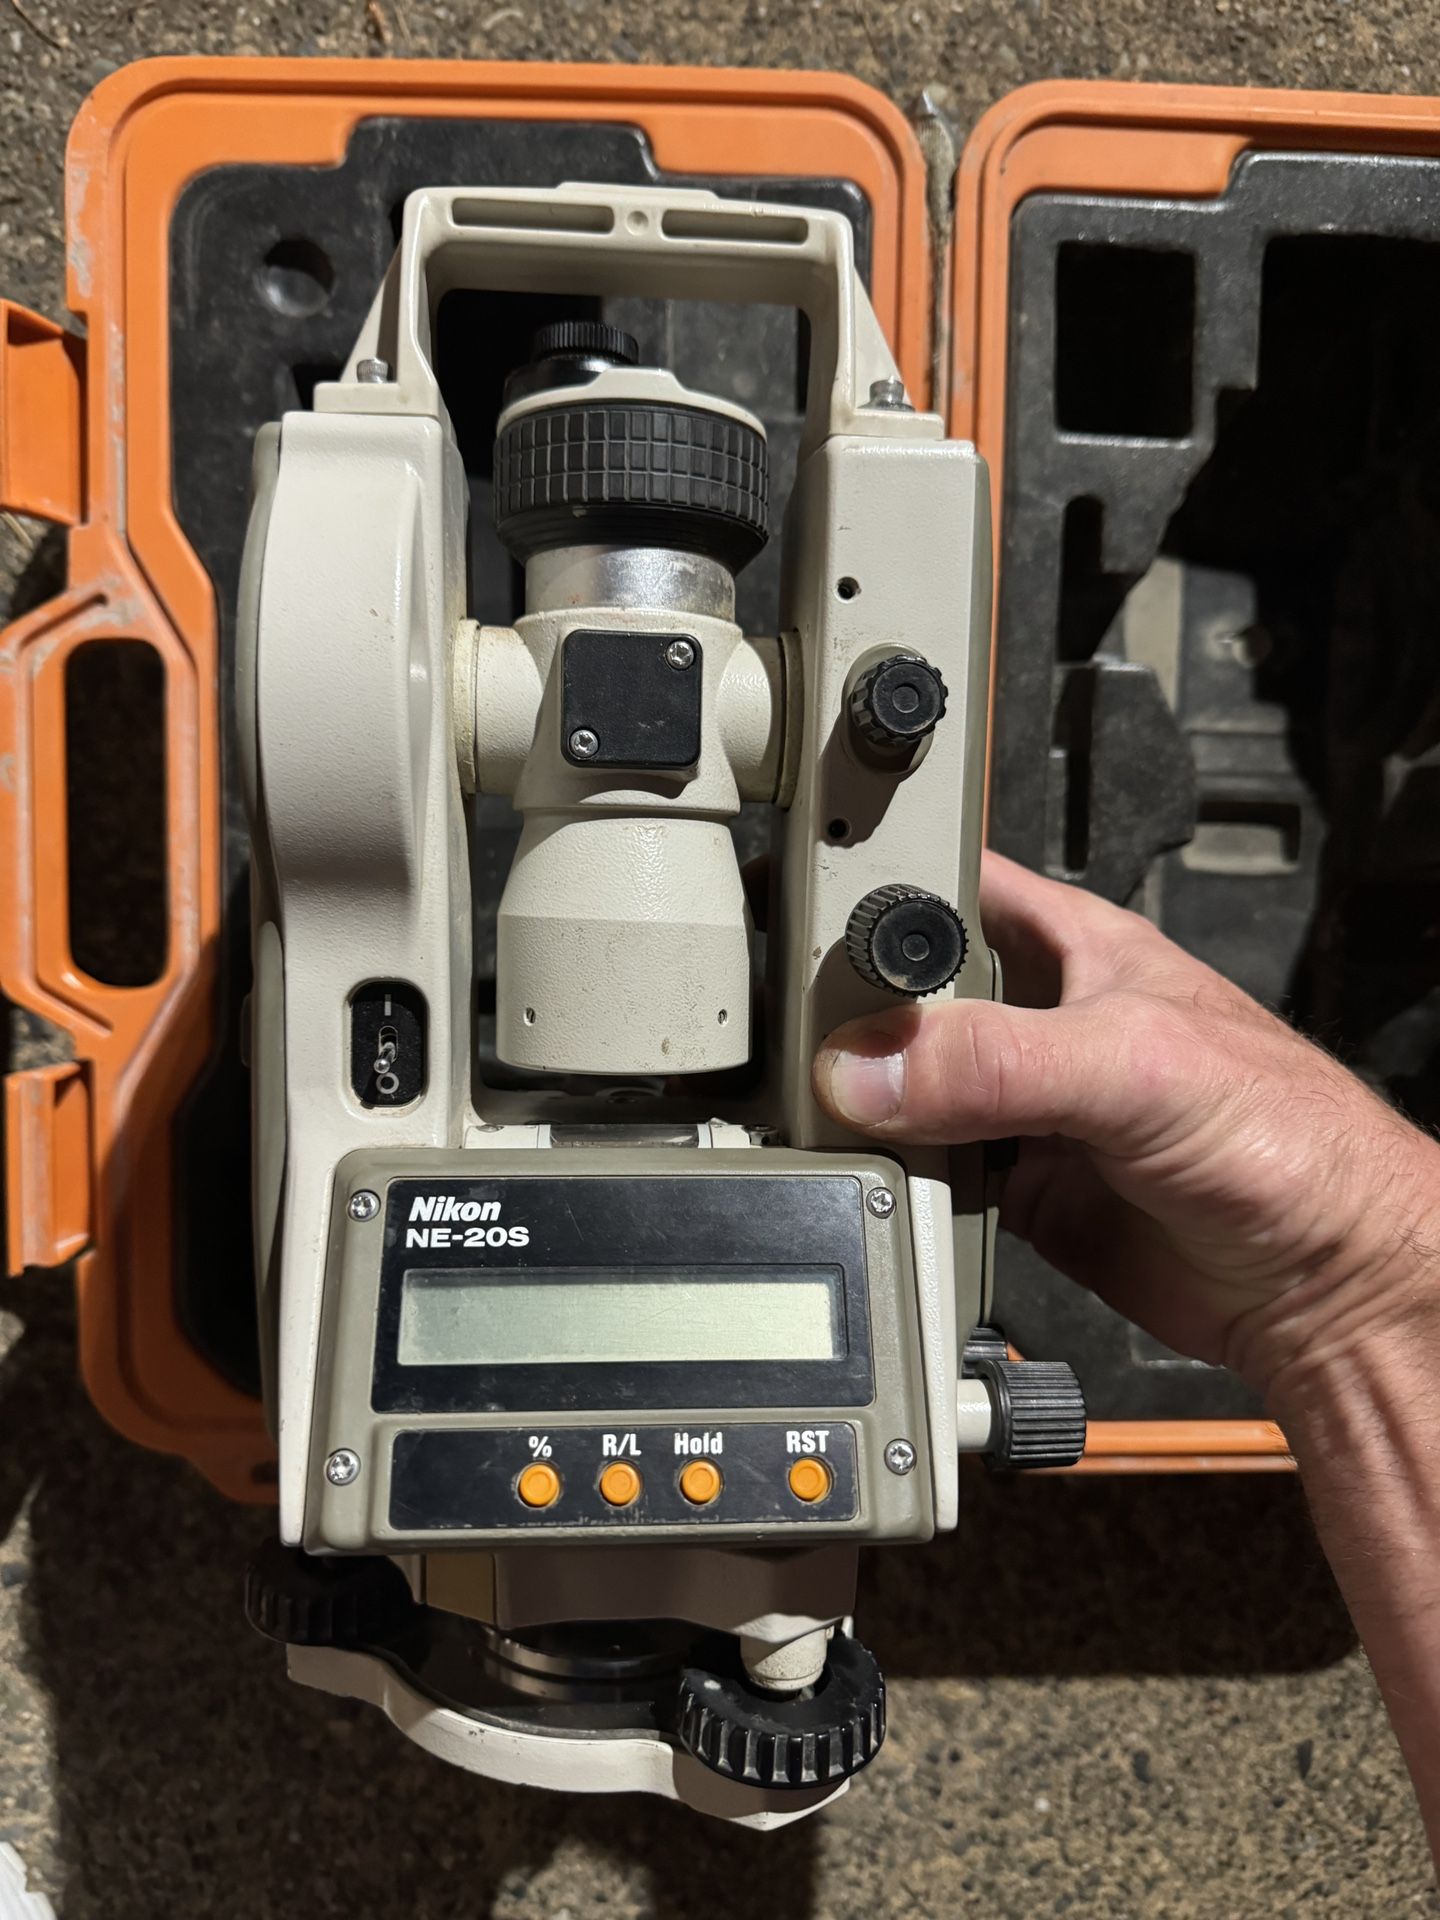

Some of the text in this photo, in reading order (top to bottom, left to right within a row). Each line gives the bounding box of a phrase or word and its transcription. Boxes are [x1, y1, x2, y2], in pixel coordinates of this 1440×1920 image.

[408, 1196, 502, 1222] Nikon
[405, 1226, 530, 1248] NE-20S
[528, 1430, 830, 1457] % R/L Hold RST
